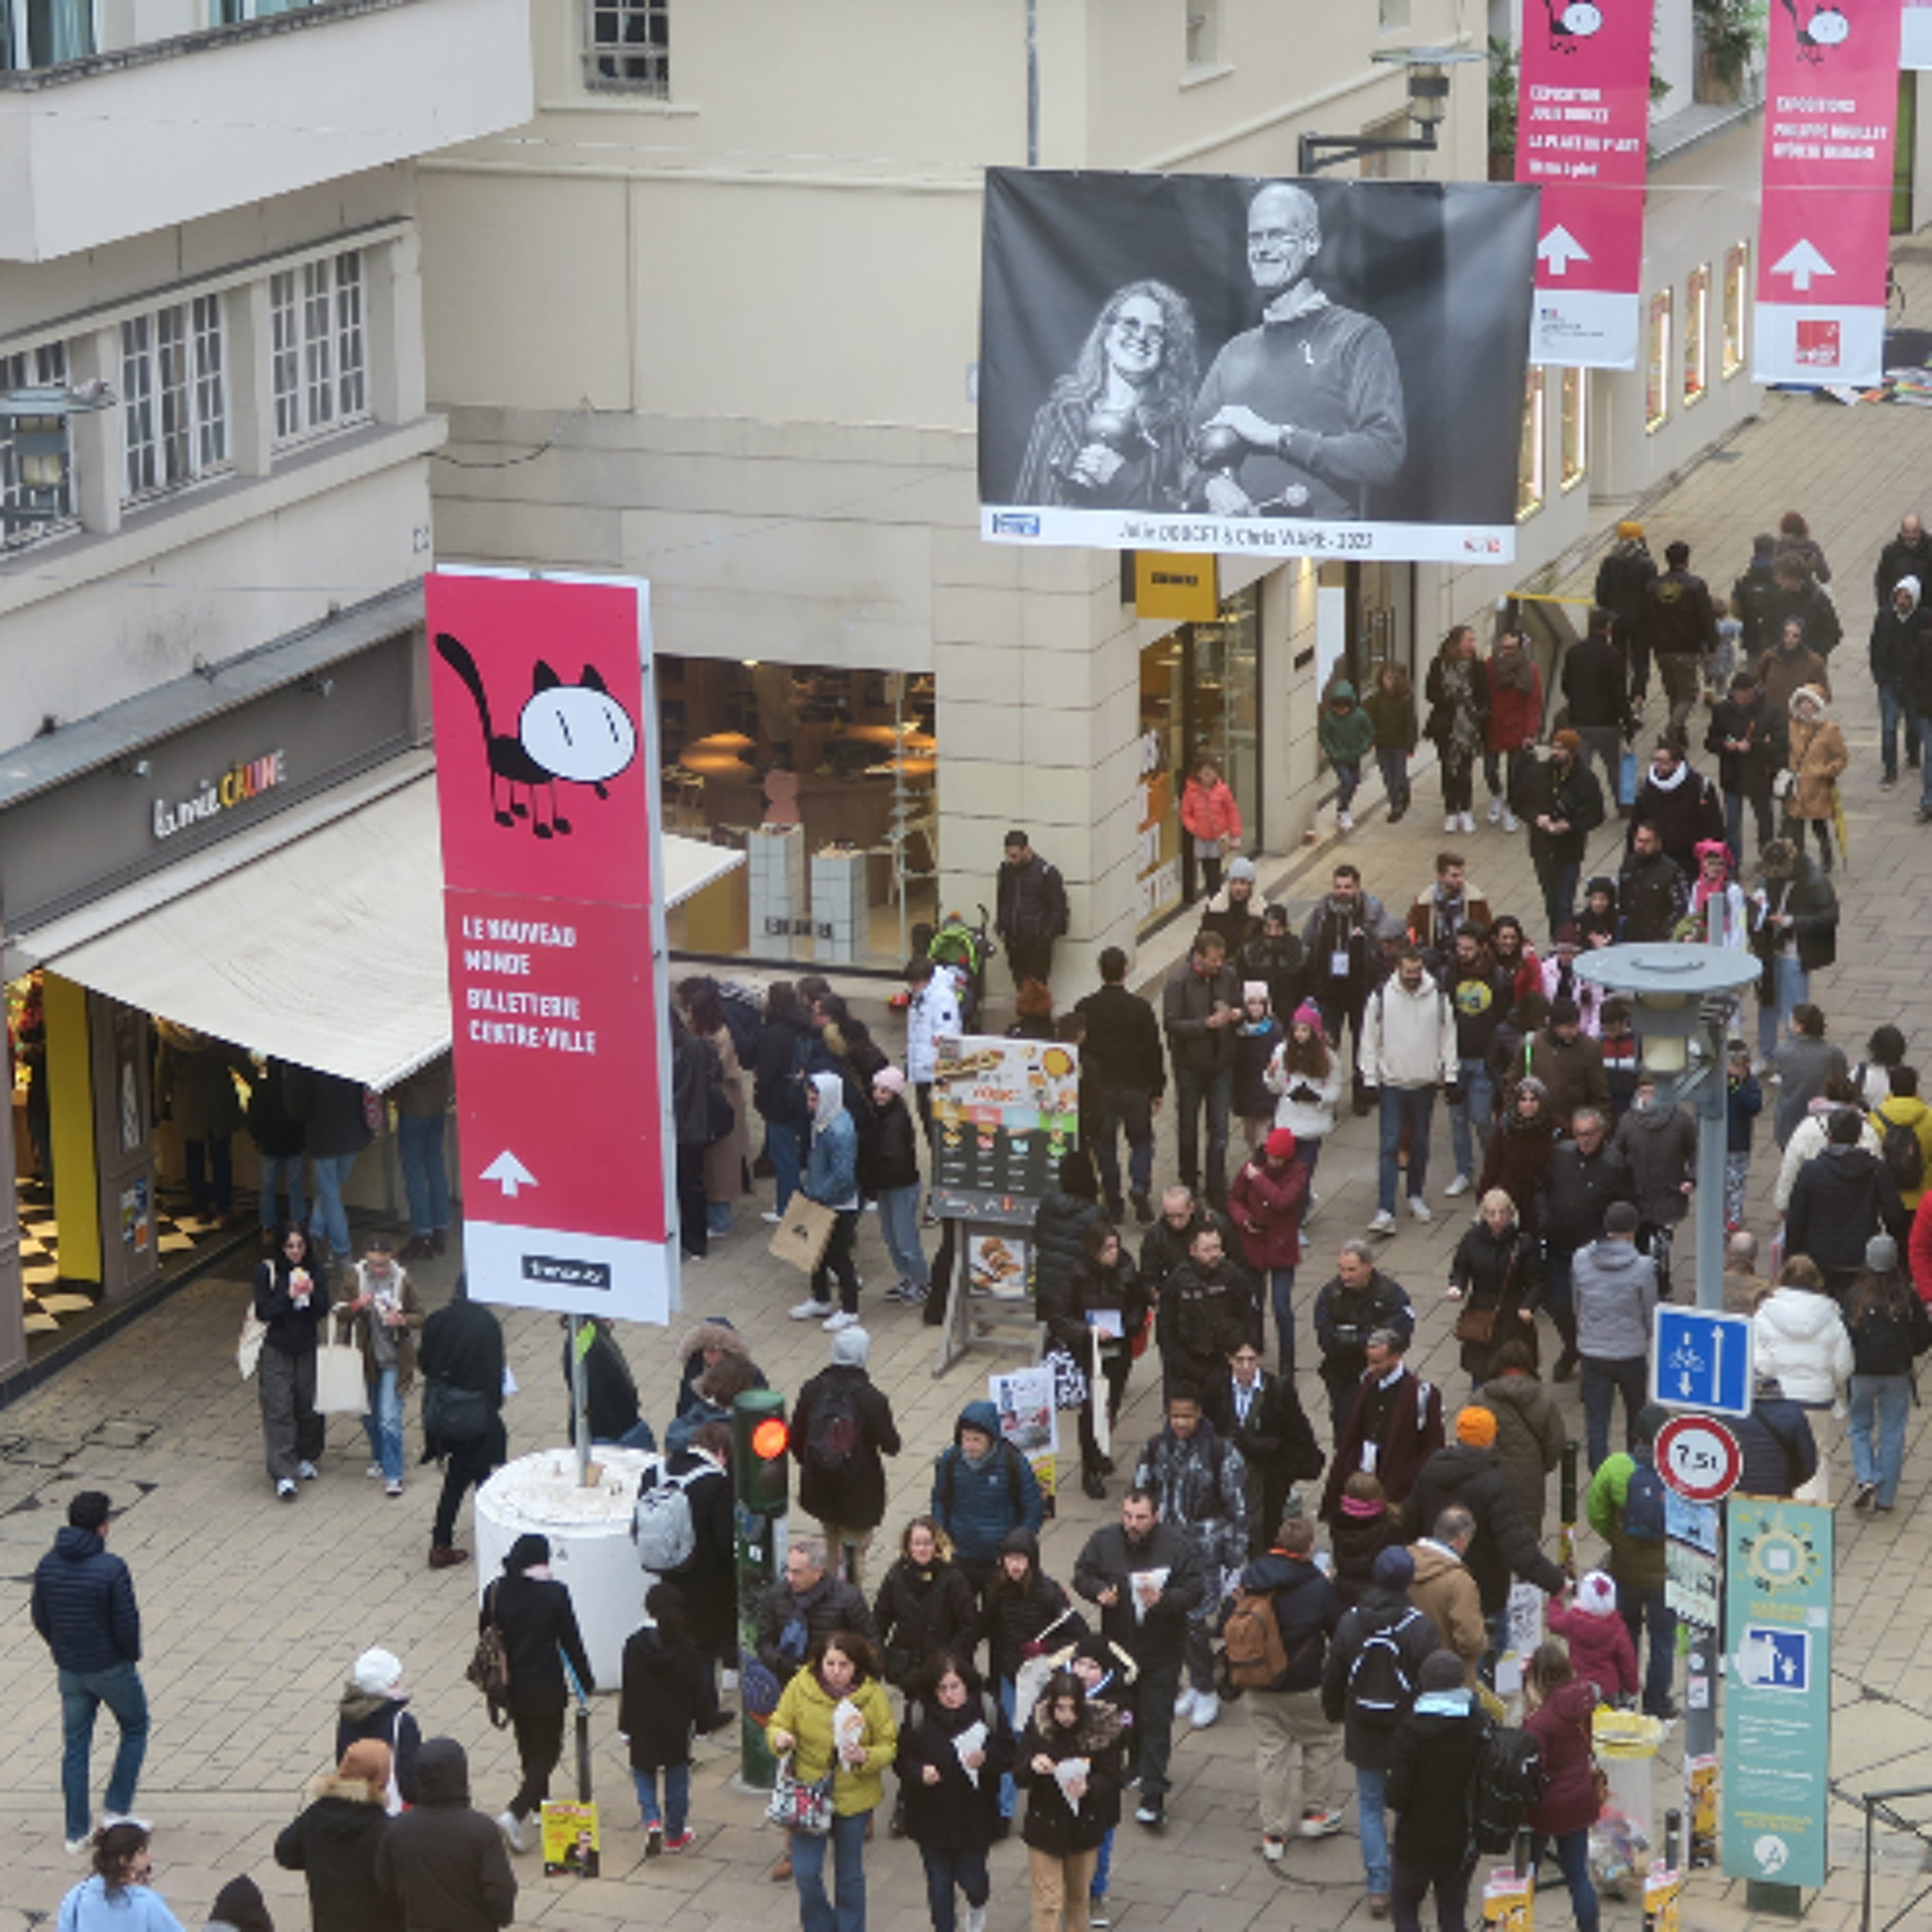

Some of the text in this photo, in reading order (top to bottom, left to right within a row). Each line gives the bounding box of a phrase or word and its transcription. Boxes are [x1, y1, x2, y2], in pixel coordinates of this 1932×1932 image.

[462, 915, 576, 948] LE NOUVEAU
[464, 949, 531, 975] MONDE
[467, 989, 580, 1021] BILLETTERIE
[469, 1019, 596, 1056] CENTRE-VILLE
